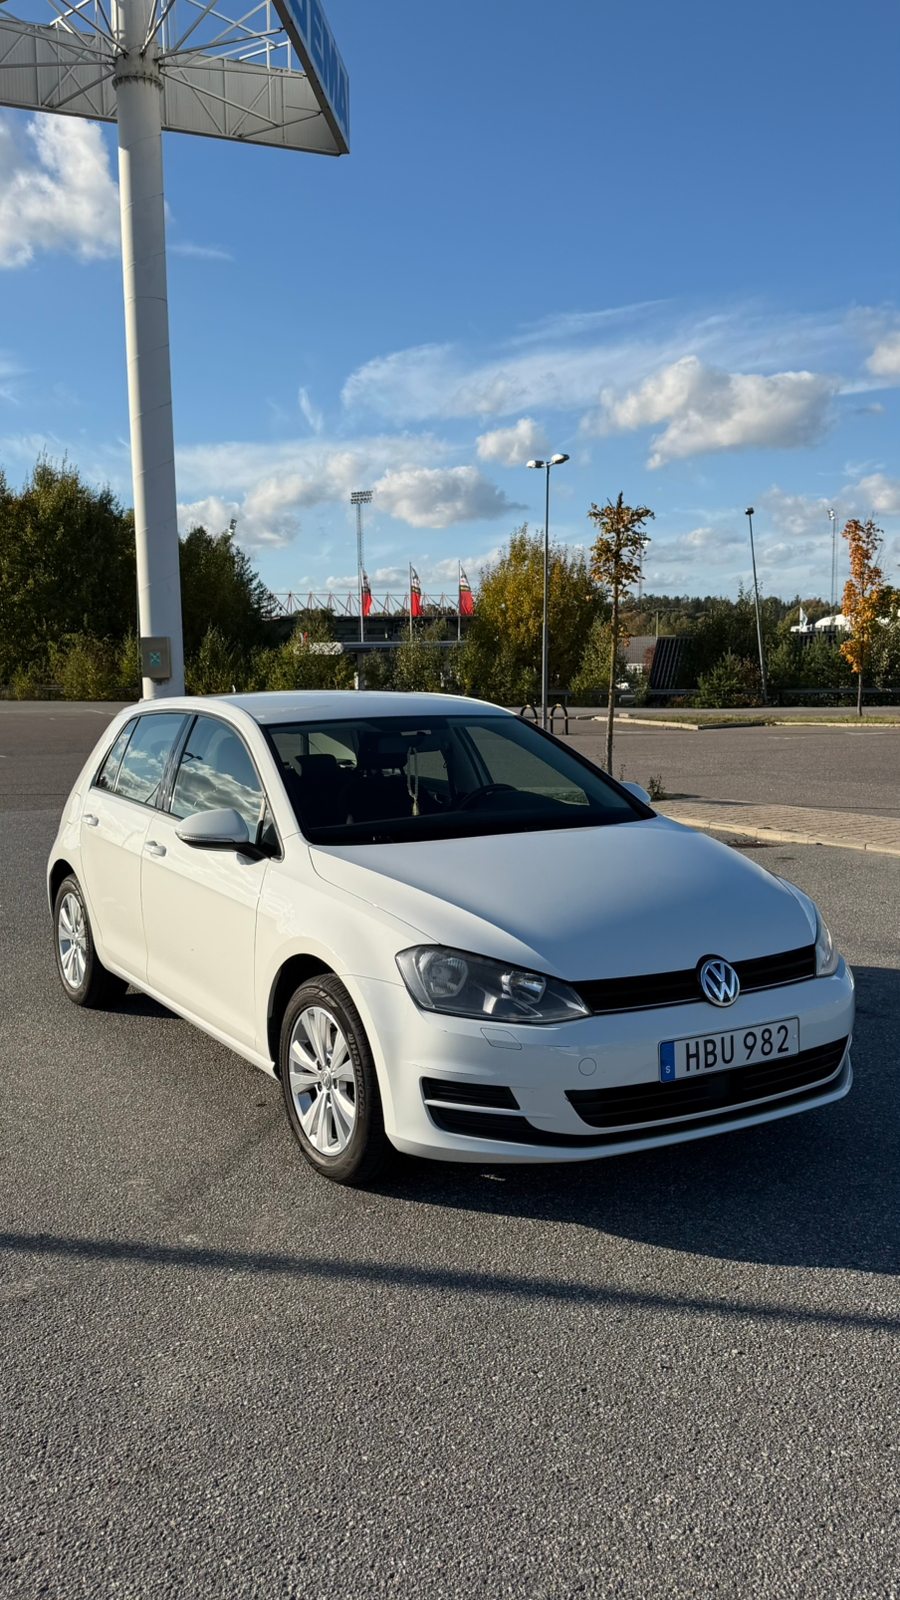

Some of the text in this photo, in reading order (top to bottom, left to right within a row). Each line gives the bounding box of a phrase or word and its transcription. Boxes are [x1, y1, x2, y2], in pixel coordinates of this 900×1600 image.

[702, 960, 739, 1005] VW
[665, 1065, 671, 1074] S
[685, 1025, 789, 1072] HBU 982
